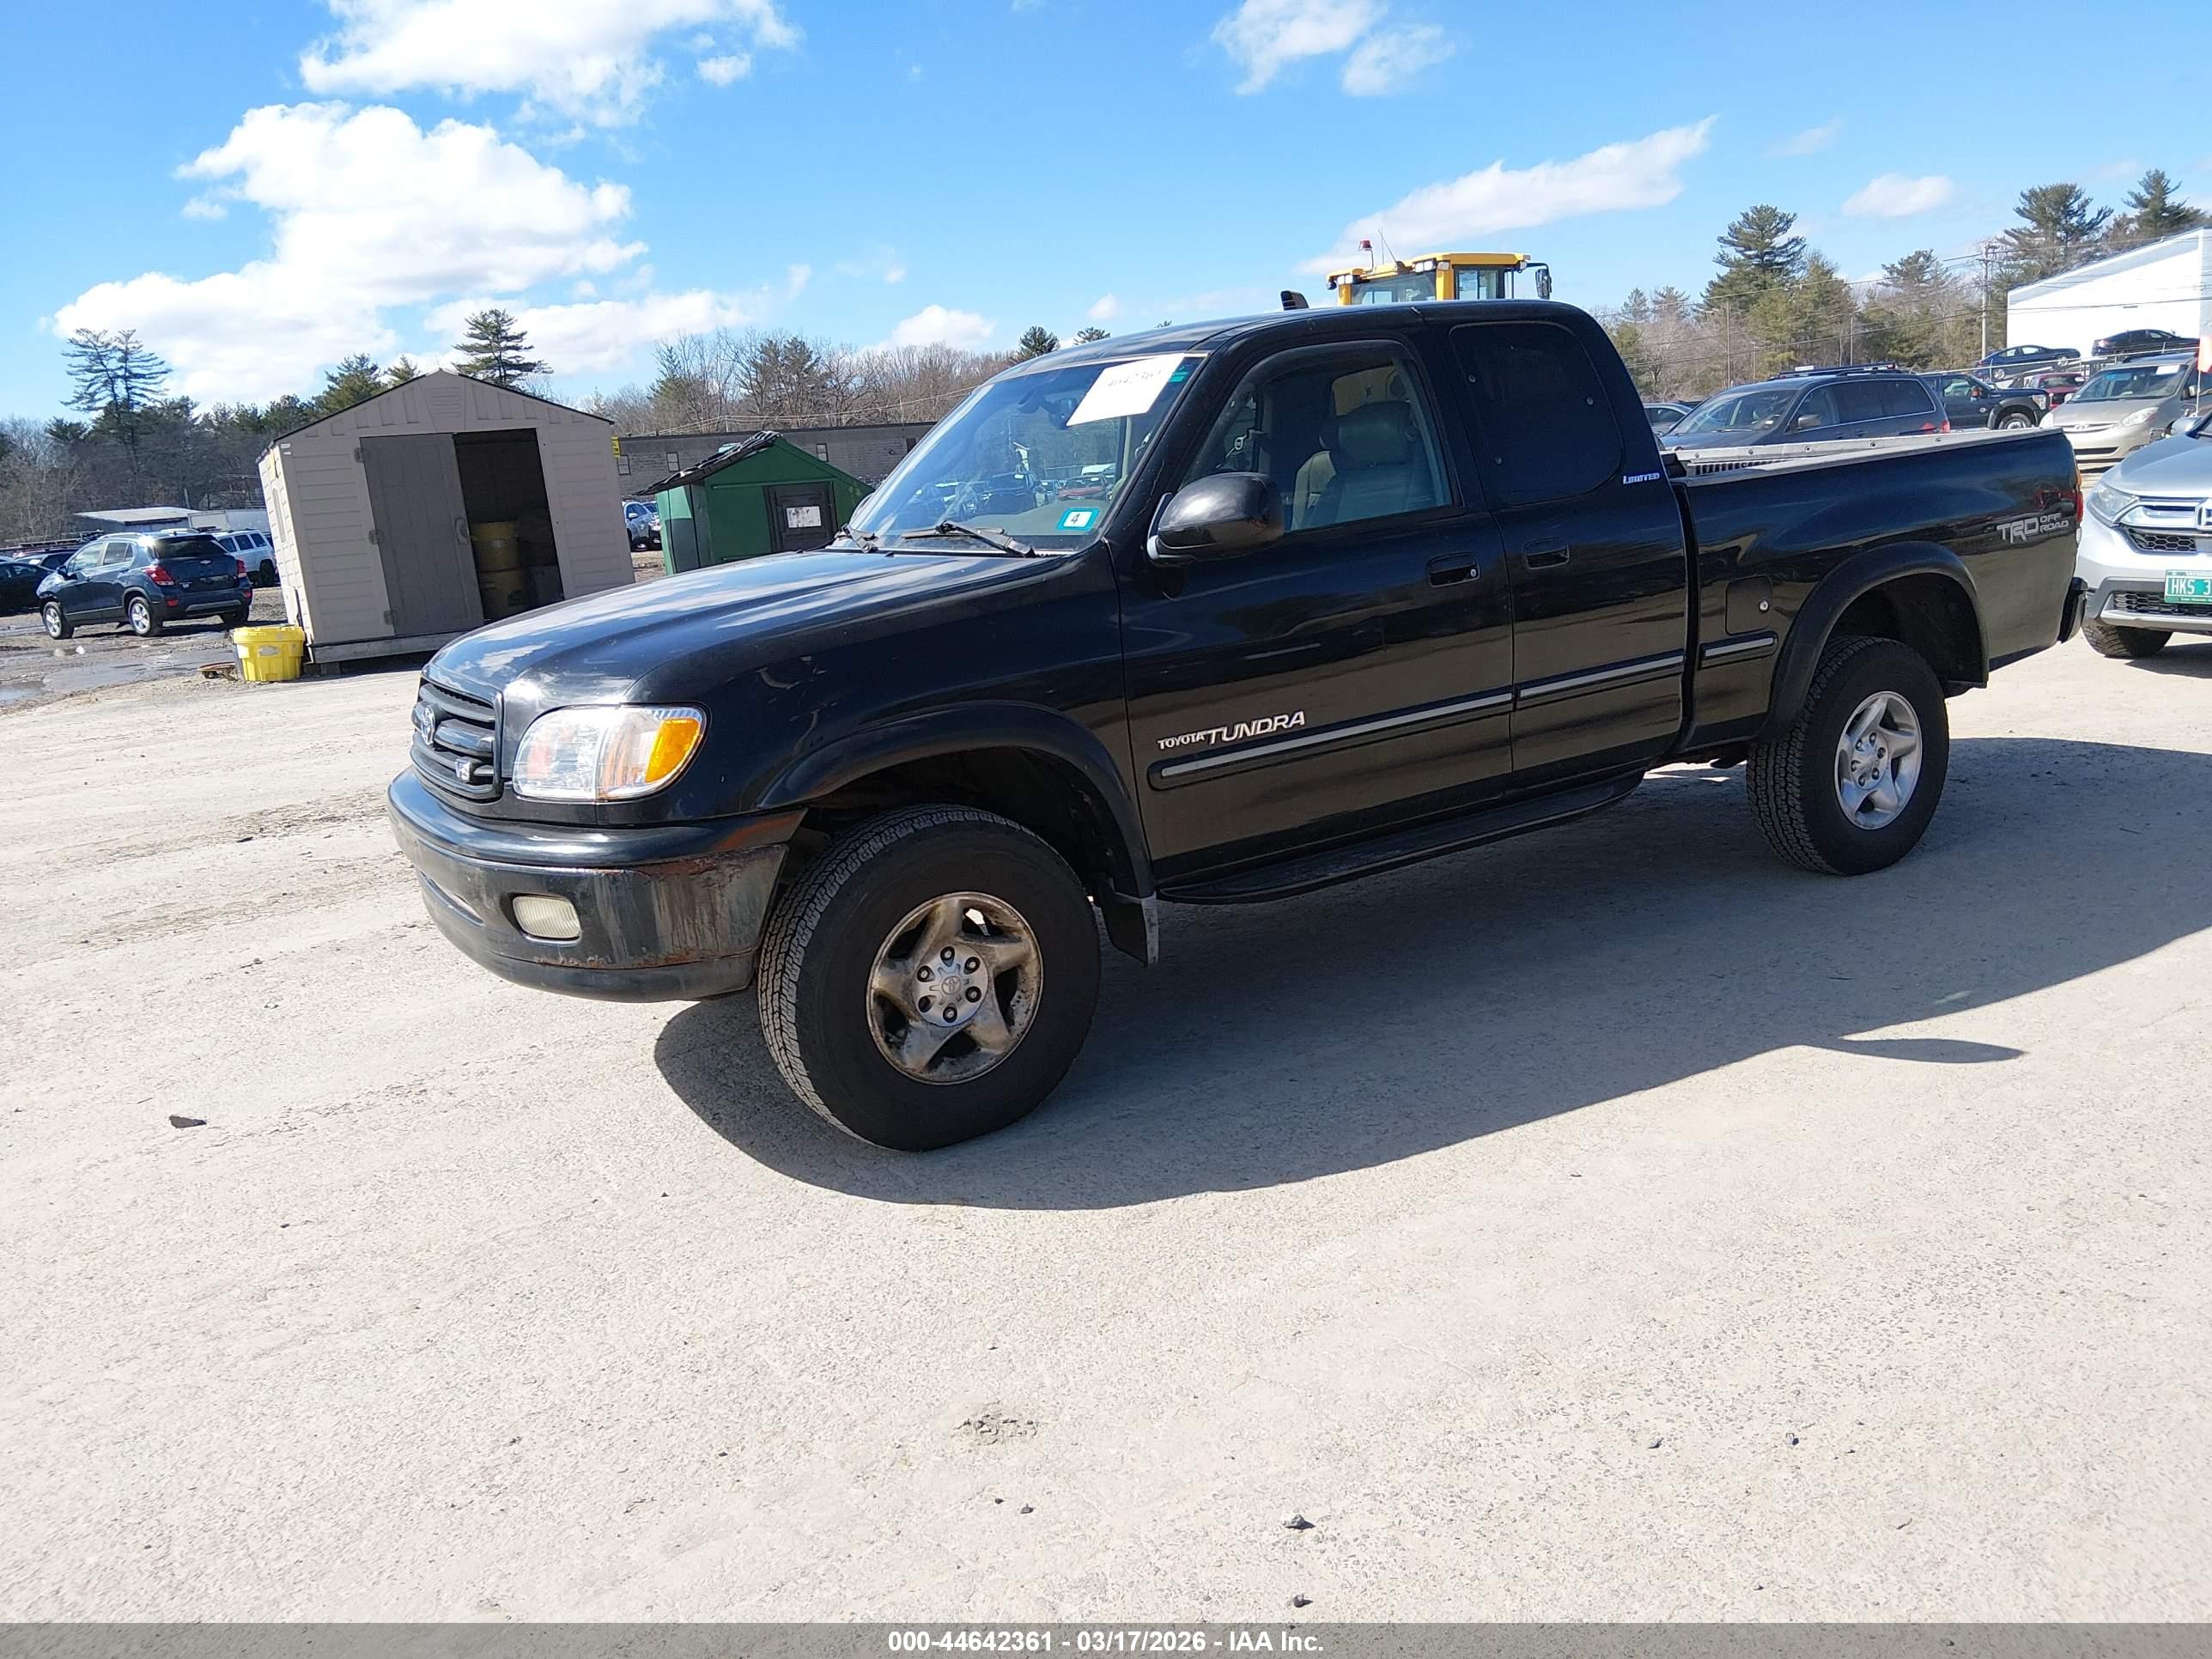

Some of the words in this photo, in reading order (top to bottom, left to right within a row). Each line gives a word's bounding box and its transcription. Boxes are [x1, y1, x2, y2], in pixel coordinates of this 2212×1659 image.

[1622, 472, 1660, 484] LIMITED
[1071, 513, 1080, 524] 4
[1996, 517, 2039, 544] TRD
[2039, 513, 2061, 523] OFF
[2039, 520, 2069, 532] ROAD
[2171, 578, 2195, 595] HKS
[1157, 732, 1206, 750] TOYOTA
[1204, 711, 1305, 745] TUNDRA
